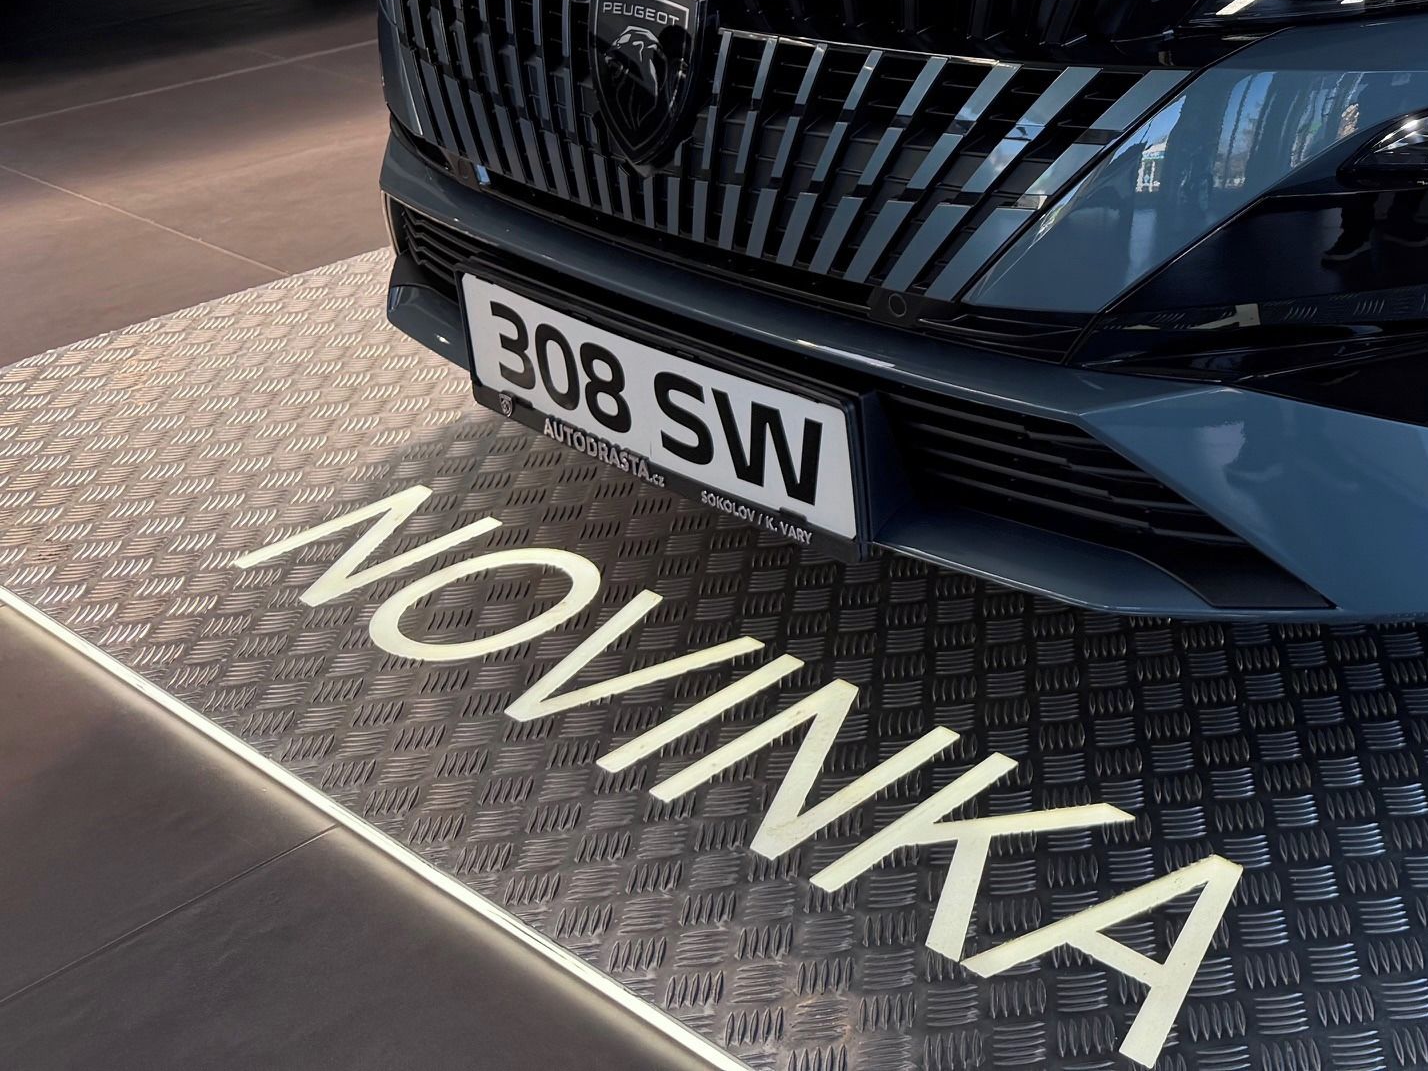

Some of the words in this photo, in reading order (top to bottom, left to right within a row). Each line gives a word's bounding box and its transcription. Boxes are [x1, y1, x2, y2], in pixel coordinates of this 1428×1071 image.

[602, 1, 680, 27] PEUGEOT
[489, 300, 632, 434] 308
[653, 370, 824, 507] SW
[542, 417, 666, 488] AUTODRASTA.cz
[700, 489, 757, 523] SOKOLOV
[764, 514, 778, 532] K.
[779, 519, 813, 545] VARY
[232, 484, 1243, 1067] NOVINKA
